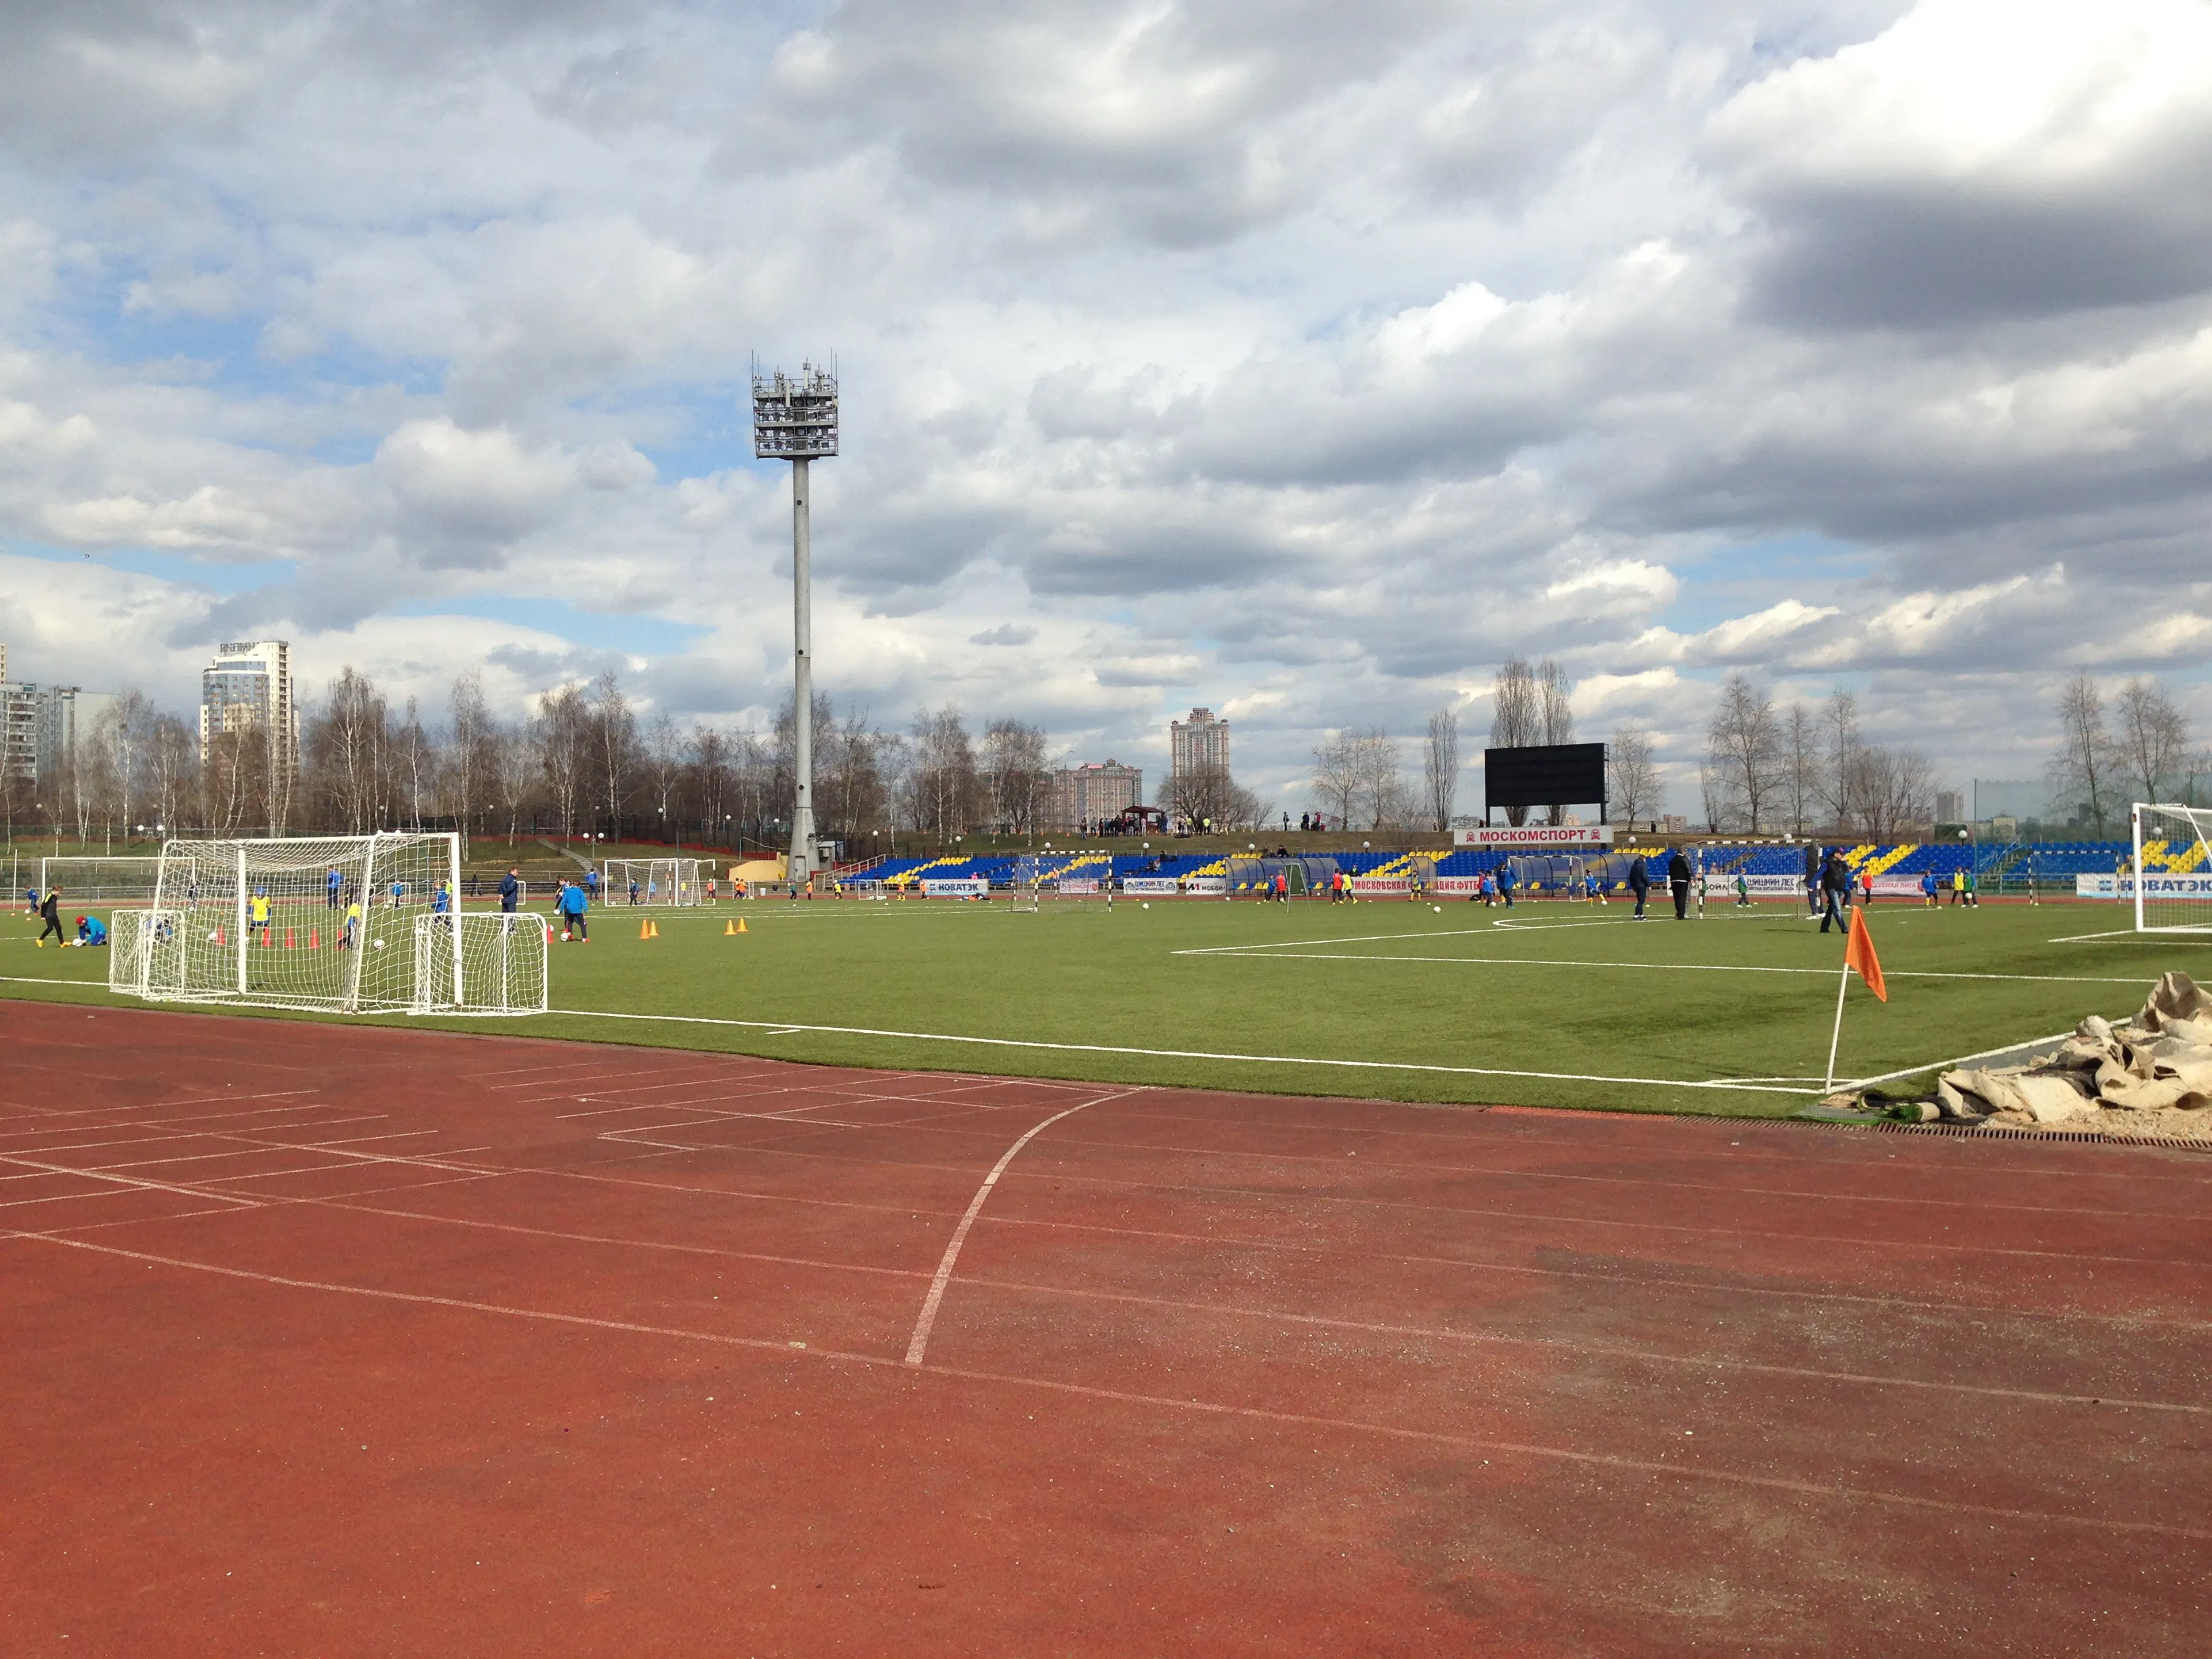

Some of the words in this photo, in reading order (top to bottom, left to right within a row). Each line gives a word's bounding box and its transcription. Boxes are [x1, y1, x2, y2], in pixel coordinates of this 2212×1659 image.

[1480, 830, 1586, 842] МОСКОМСПОРТ
[938, 883, 979, 891] НОВАТЭК
[1355, 881, 1406, 890] МОСКОВСКАЯ
